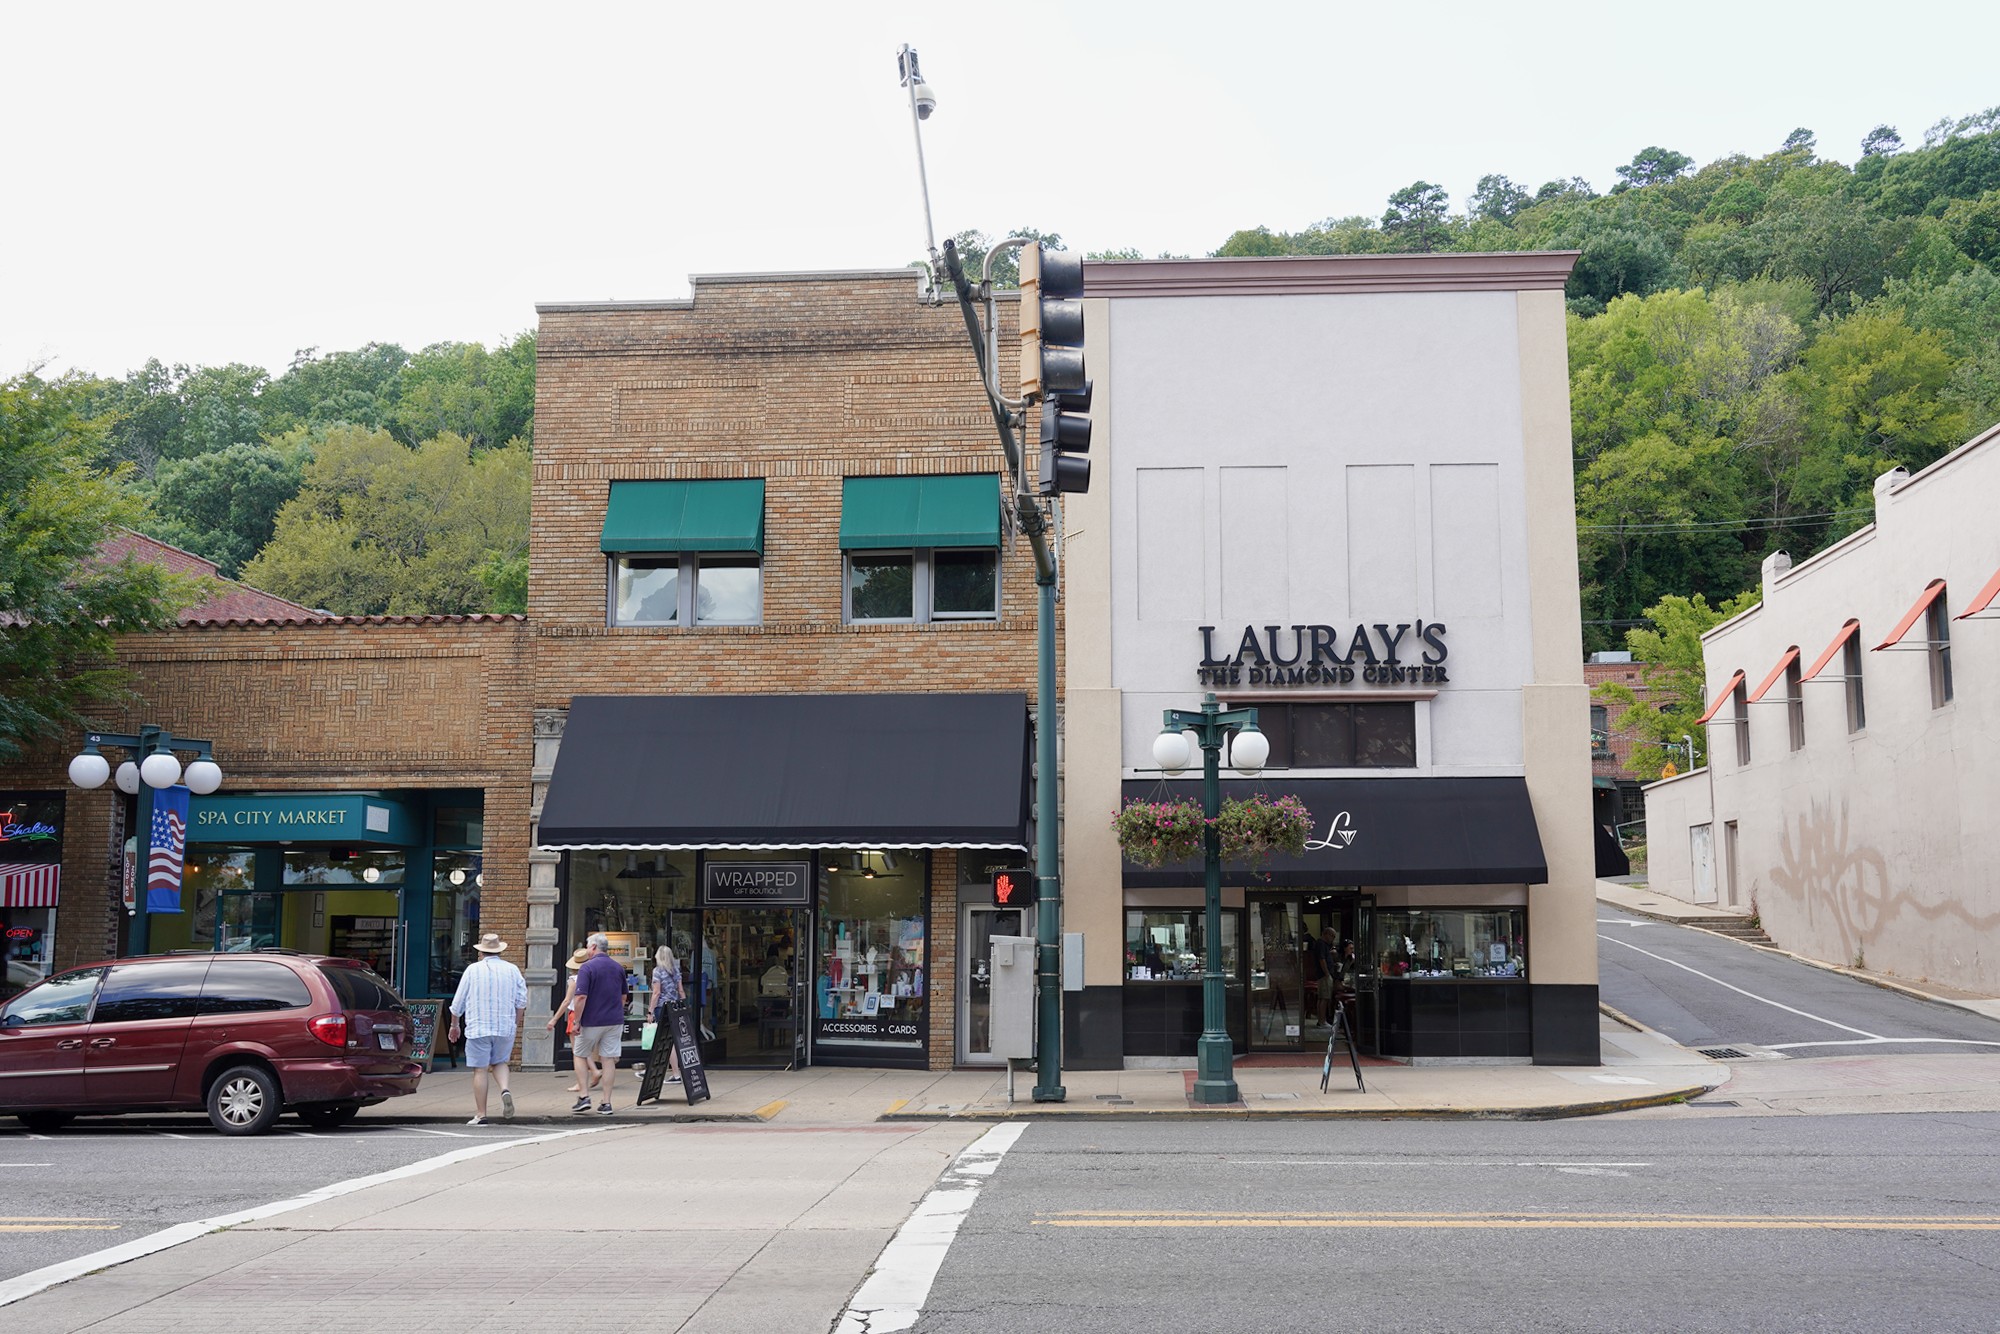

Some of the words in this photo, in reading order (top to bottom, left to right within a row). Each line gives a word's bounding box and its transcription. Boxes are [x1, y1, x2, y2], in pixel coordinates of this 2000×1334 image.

[1198, 619, 1448, 667] LAURAY'S
[1197, 666, 1241, 685] THE
[1248, 665, 1354, 684] DIAMOND
[1363, 665, 1450, 684] CENTER
[198, 811, 228, 825] SPA
[234, 811, 273, 825] CITY
[278, 810, 347, 824] MARKET
[2, 821, 56, 838] Shakes
[715, 871, 797, 887] WRAPPED
[733, 887, 748, 895] GIFT
[749, 887, 783, 895] BOUTIQUE
[6, 929, 34, 938] OPEN
[822, 1023, 878, 1034] ACCESSORIES
[888, 1024, 917, 1035] CARDS
[682, 1049, 699, 1065] OPEN
